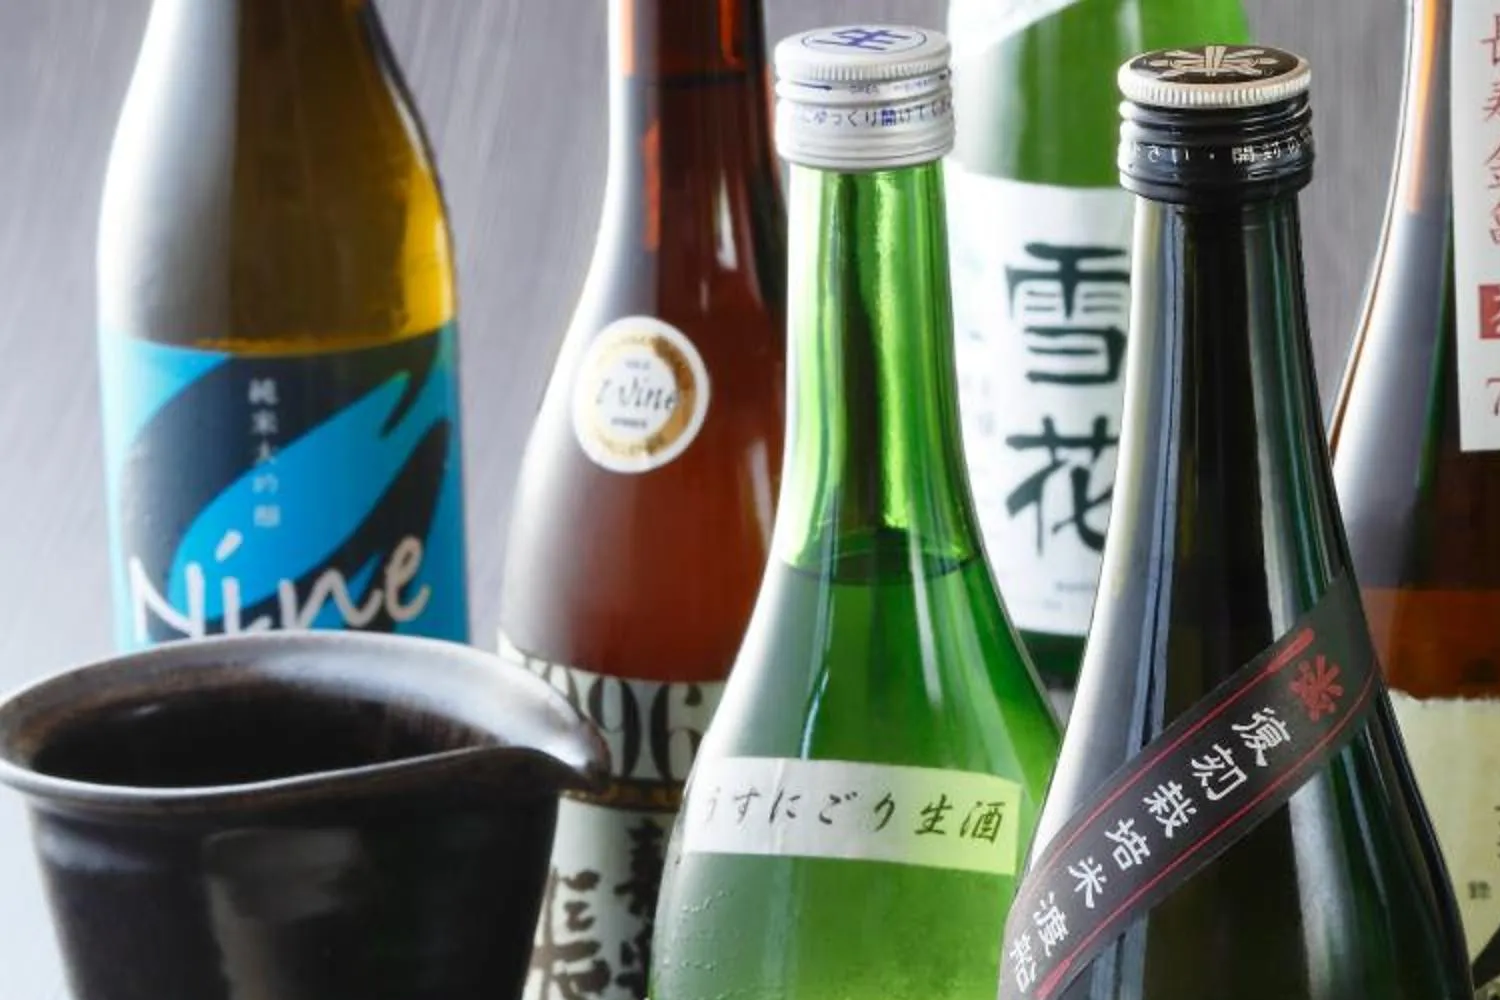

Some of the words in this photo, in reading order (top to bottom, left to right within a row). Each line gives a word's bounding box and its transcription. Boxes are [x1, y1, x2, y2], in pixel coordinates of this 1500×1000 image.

[1004, 243, 1133, 558] 雪花
[128, 528, 433, 642] Nine
[704, 786, 1007, 844] うすにごり生酒
